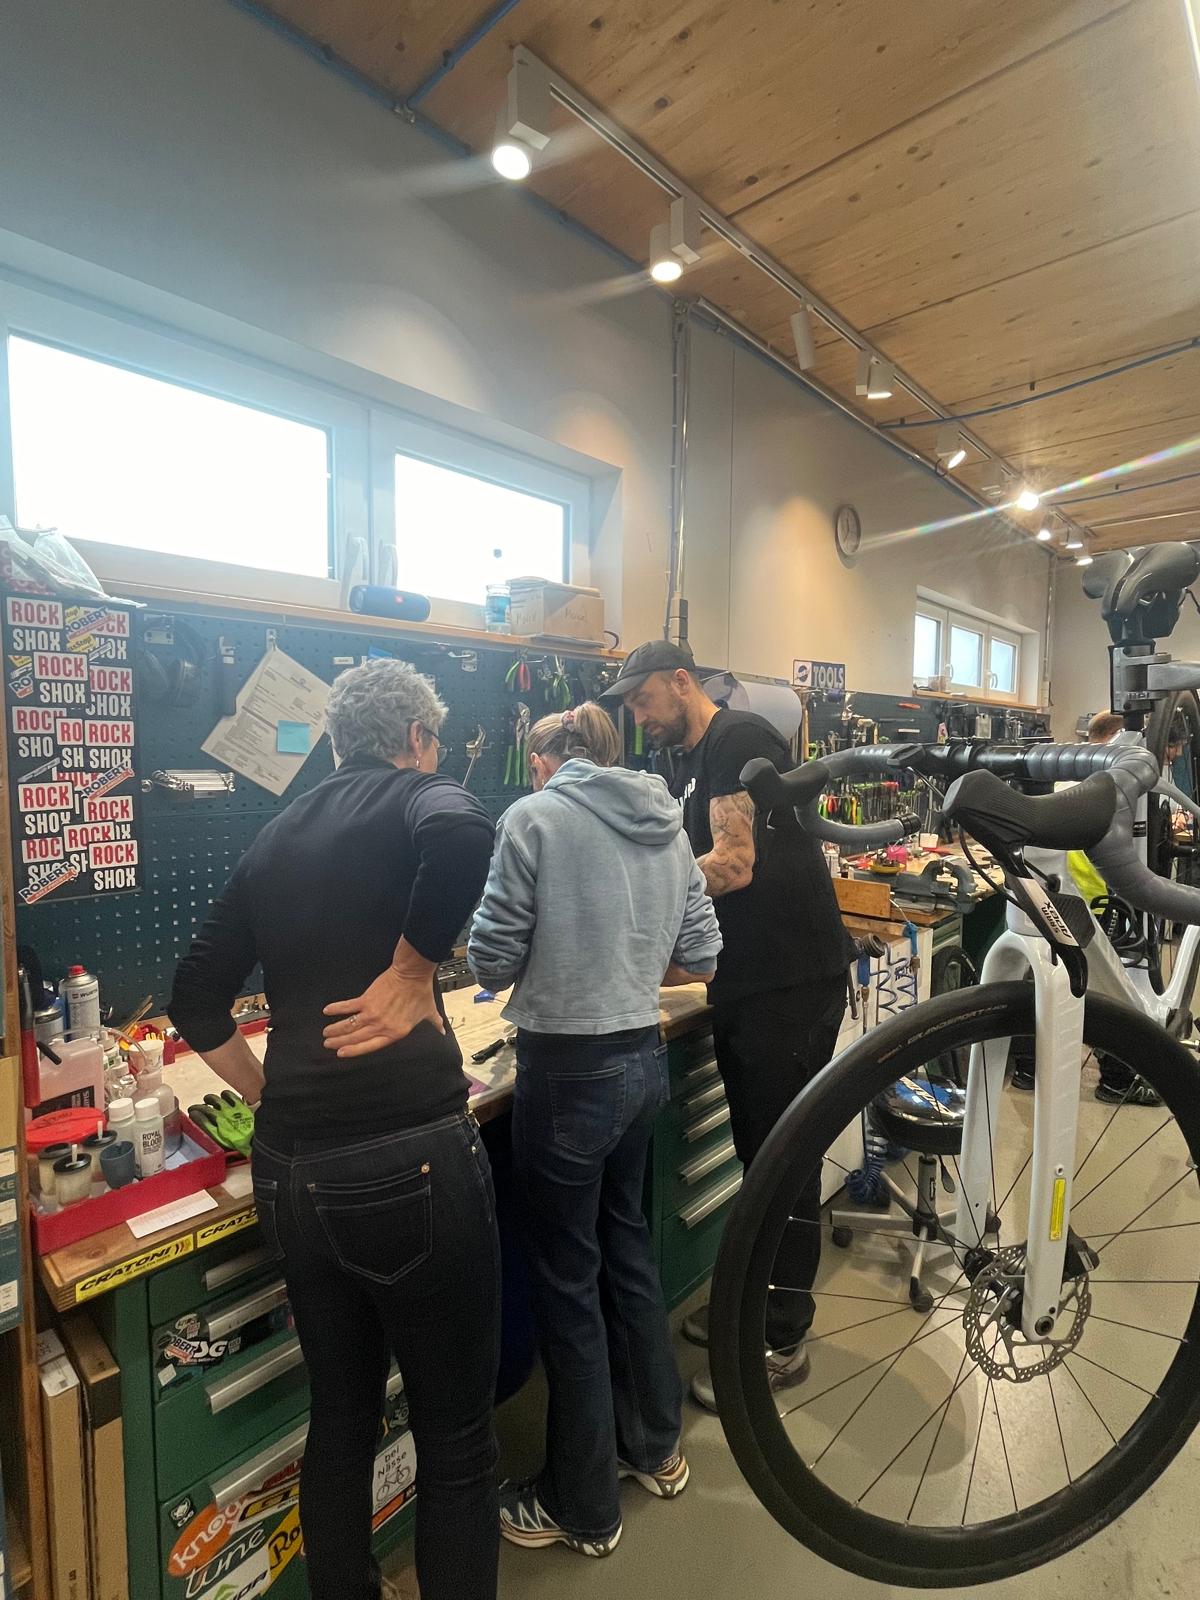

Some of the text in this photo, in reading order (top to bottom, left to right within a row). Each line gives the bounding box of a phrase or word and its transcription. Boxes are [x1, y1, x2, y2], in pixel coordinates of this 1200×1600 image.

[11, 600, 60, 626] ROCK
[64, 606, 110, 635] ROBERT
[12, 628, 61, 651] SHOX
[38, 655, 85, 678] ROCK
[813, 666, 844, 689] TOOLS
[39, 681, 86, 704] SHOX
[60, 722, 82, 742] RO
[88, 723, 131, 743] ROCK
[18, 736, 54, 758] SHO
[61, 747, 84, 769] SH
[88, 748, 132, 769] SHOX
[82, 762, 128, 796] ROBERT
[23, 785, 70, 809] ROCK
[87, 799, 130, 821] ROCK
[68, 823, 112, 849] ROCK
[26, 837, 61, 860] ROC
[92, 843, 135, 866] ROCK
[20, 864, 70, 899] ROBERT
[93, 867, 136, 891] SHOX
[142, 1130, 161, 1141] ROYAL
[200, 1207, 257, 1239] CRATO
[80, 1246, 172, 1293] CRATONI
